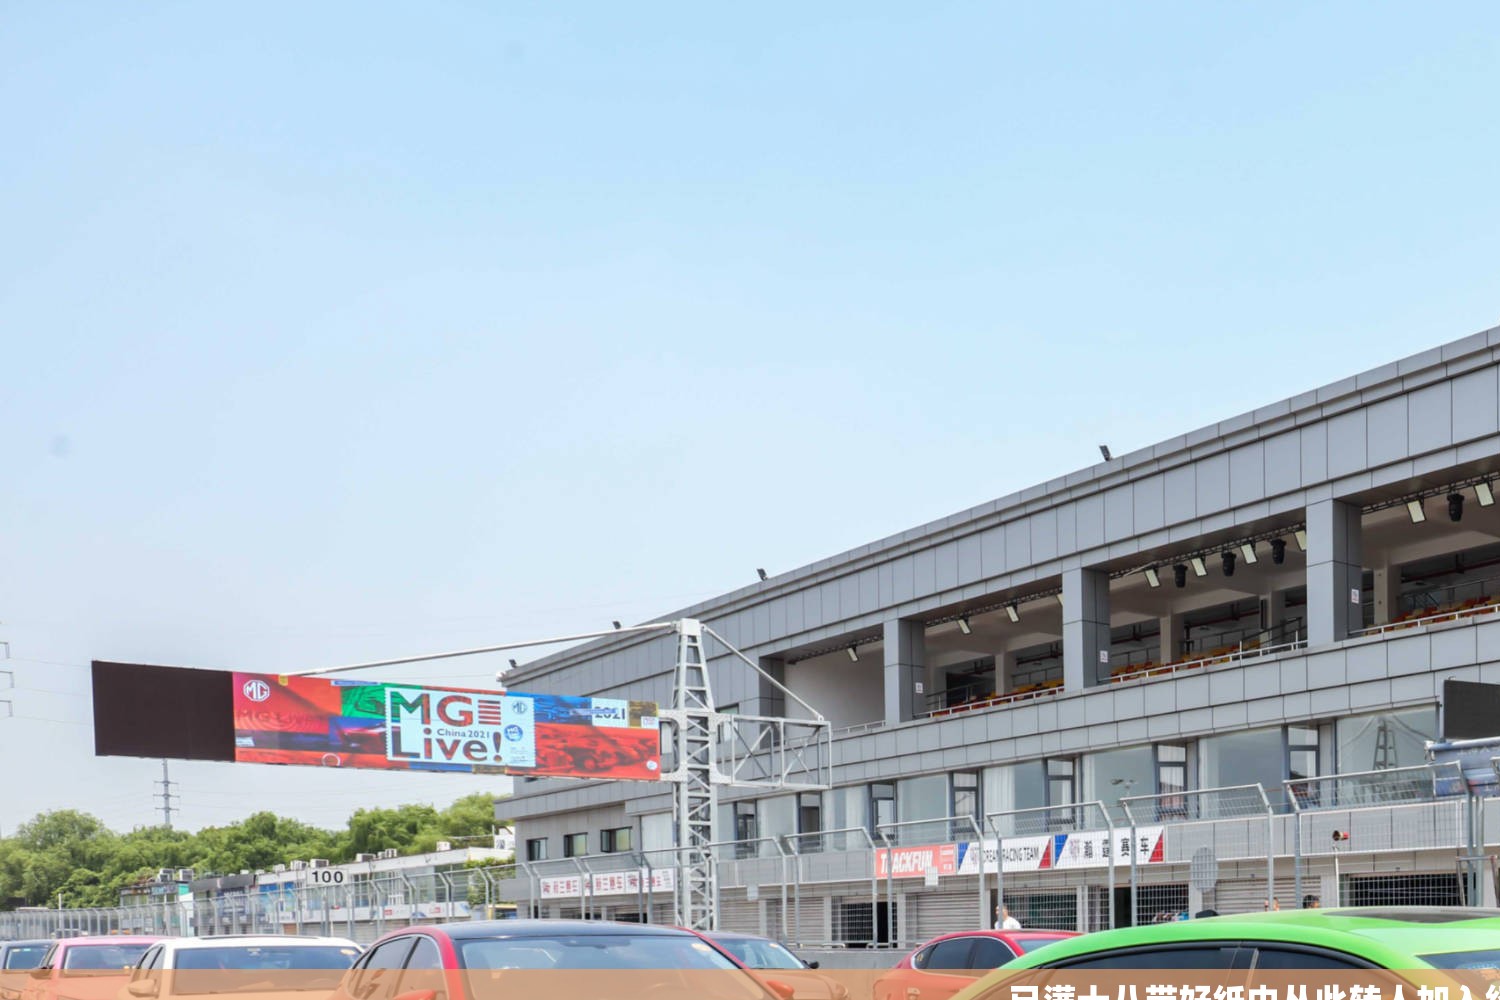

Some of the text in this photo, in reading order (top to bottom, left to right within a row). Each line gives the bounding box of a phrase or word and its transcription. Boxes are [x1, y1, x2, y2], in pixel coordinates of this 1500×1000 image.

[243, 679, 270, 701] MG
[390, 691, 473, 727] MG
[436, 728, 490, 738] China 2021
[391, 726, 503, 762] Live!
[1024, 847, 1040, 860] TEAM
[311, 871, 344, 883] 100
